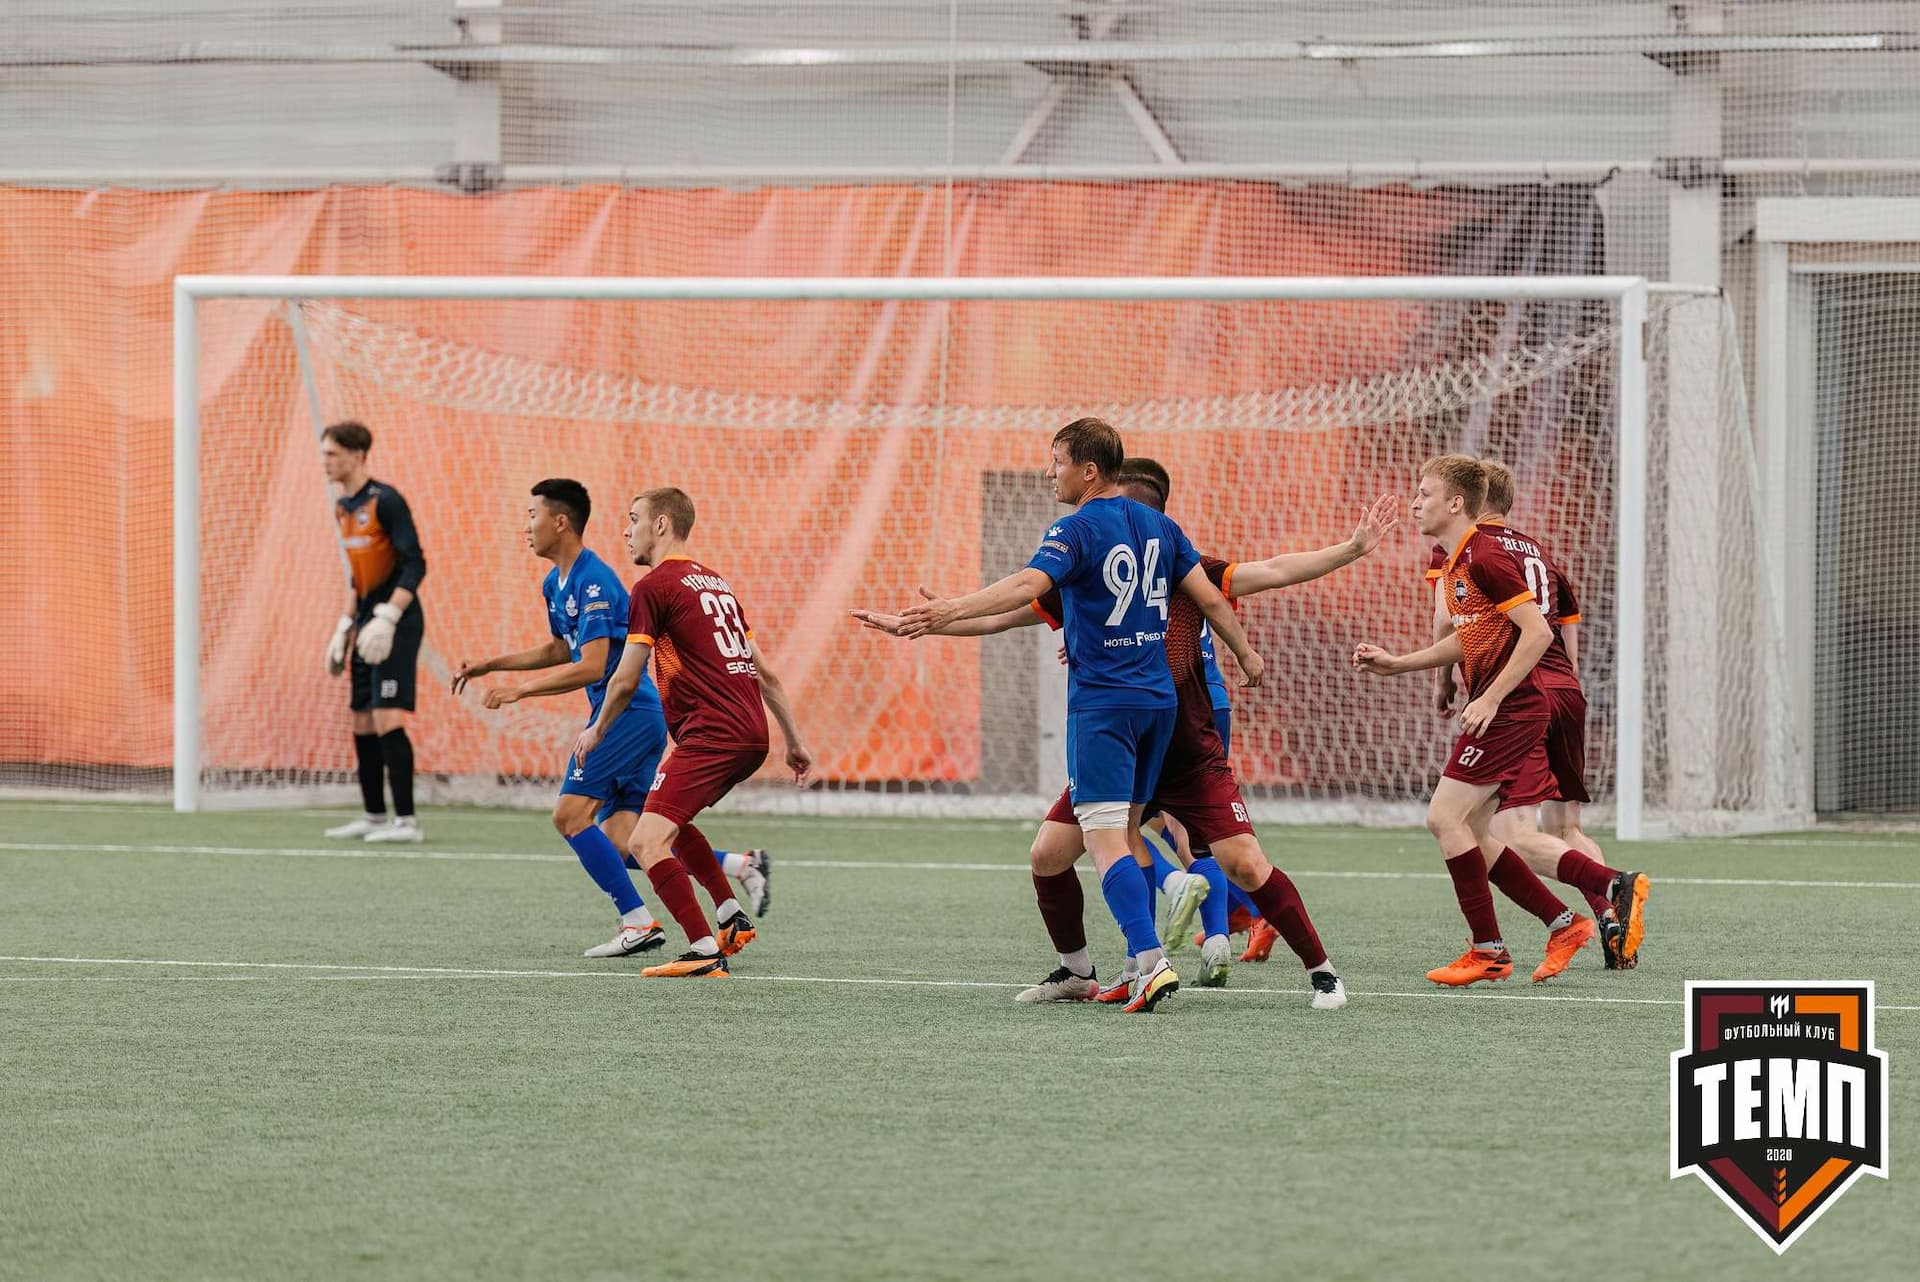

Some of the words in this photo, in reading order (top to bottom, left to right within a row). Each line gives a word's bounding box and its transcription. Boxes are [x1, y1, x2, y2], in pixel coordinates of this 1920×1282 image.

[1103, 538, 1168, 626] 94
[700, 592, 752, 658] 33
[1104, 637, 1135, 647] HOTEL
[1135, 632, 1160, 646] FRED
[1458, 745, 1484, 767] 27
